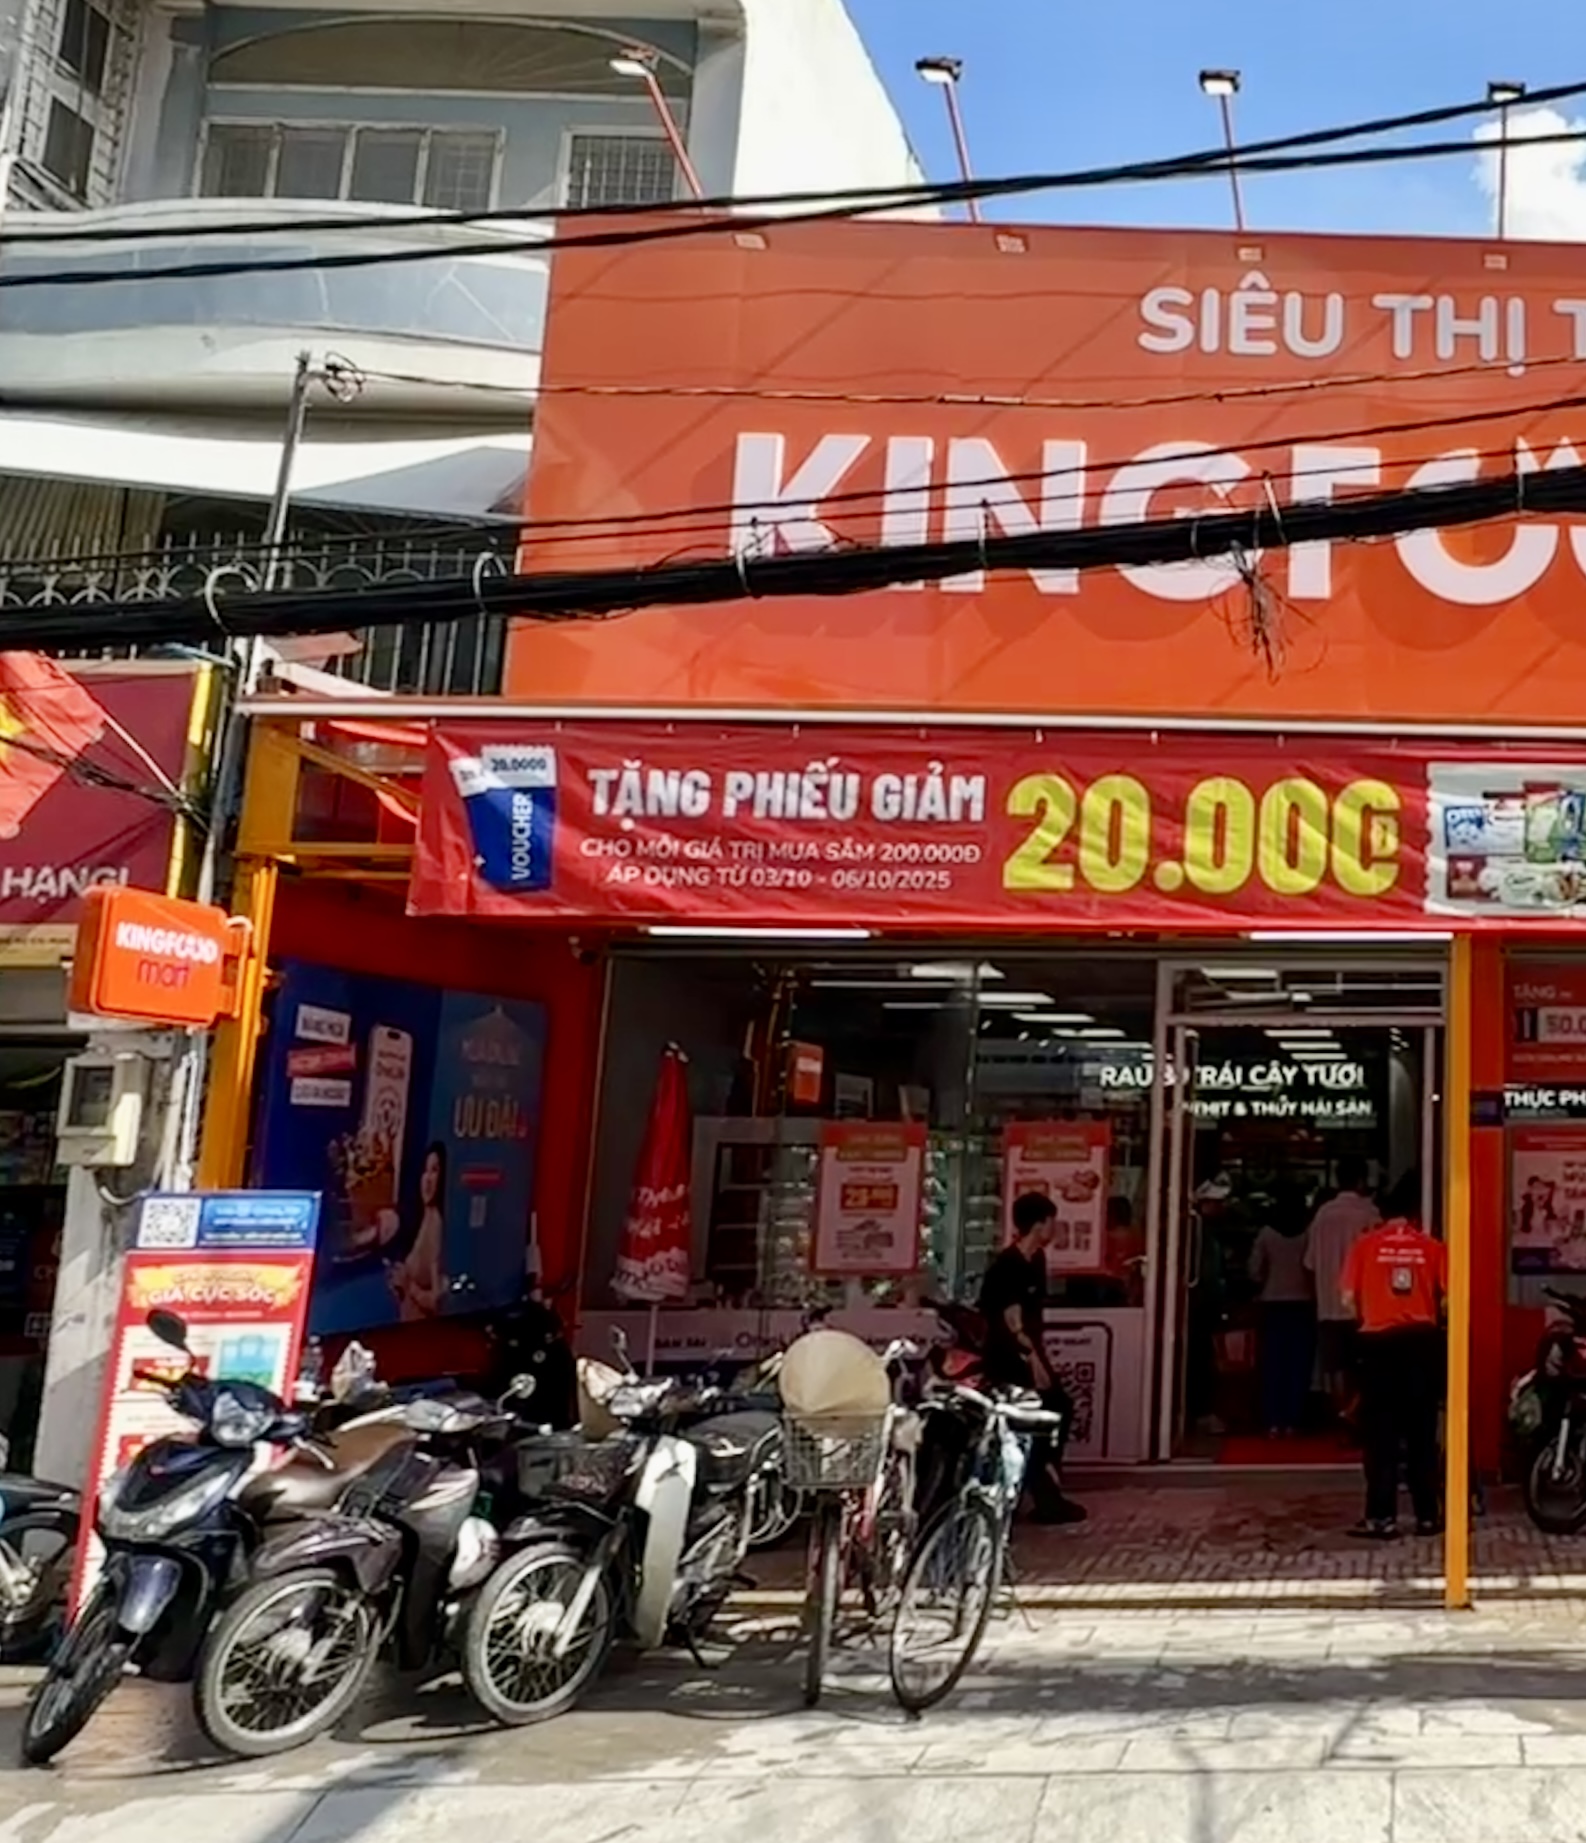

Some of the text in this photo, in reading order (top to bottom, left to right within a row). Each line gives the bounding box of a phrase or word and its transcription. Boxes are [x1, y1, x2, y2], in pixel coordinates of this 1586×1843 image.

[1138, 271, 1344, 357] SIÊU
[1372, 292, 1526, 376] THỊ
[587, 756, 985, 832] TẶNG PHIẾU GIẢM
[511, 792, 534, 881] VOUCHER
[580, 840, 631, 860] CHO
[683, 836, 725, 860] GIÁ
[727, 840, 765, 864] TRỊ
[768, 842, 820, 862] MUA
[605, 862, 641, 885] ÁP
[643, 865, 710, 890] DỤNG
[715, 862, 751, 887] TỪ
[751, 866, 812, 889] 03/10
[831, 867, 952, 891] 06/10/2025
[115, 921, 220, 965] KINGFOOD
[1099, 1063, 1153, 1087] RAU
[1248, 1058, 1299, 1088] CÂY
[1302, 1062, 1365, 1088] TƯƠI
[1502, 1088, 1556, 1109] THỰC
